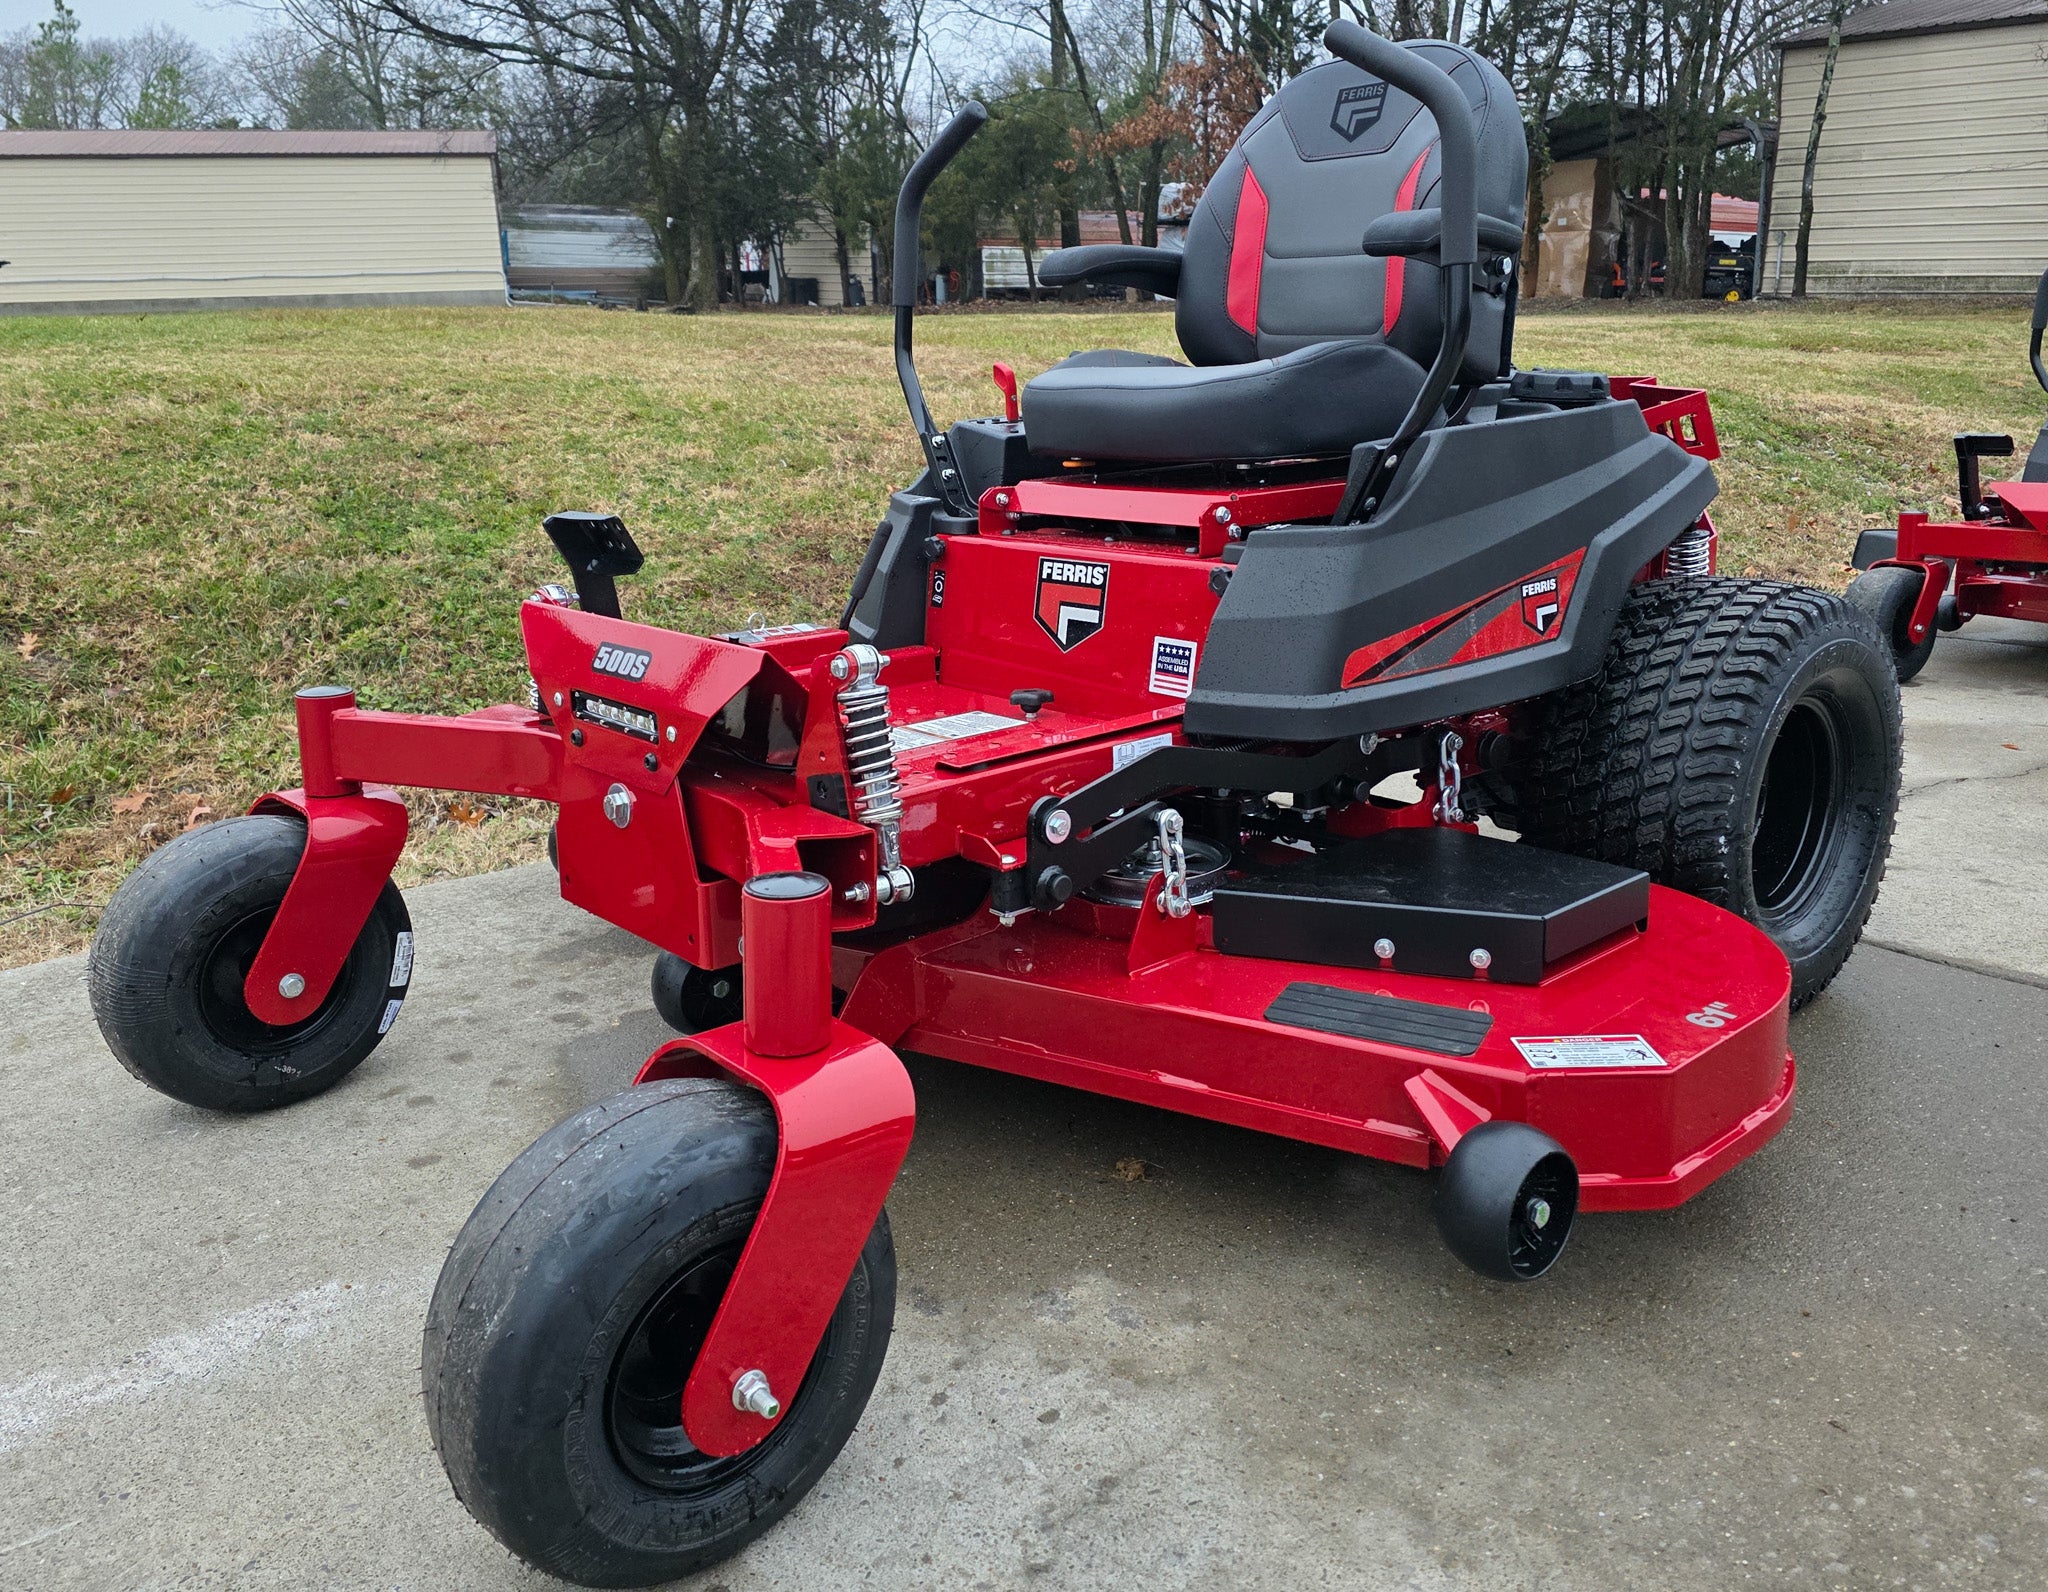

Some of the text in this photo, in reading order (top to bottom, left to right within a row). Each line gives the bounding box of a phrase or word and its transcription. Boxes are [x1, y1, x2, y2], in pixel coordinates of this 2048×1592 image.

[1341, 84, 1385, 101] FERRIS
[1041, 561, 1105, 586] FERRIS
[1522, 578, 1557, 597] FERRIS
[593, 646, 650, 679] 500S
[1158, 655, 1189, 666] ASSEMBLED
[1173, 665, 1188, 674] USA
